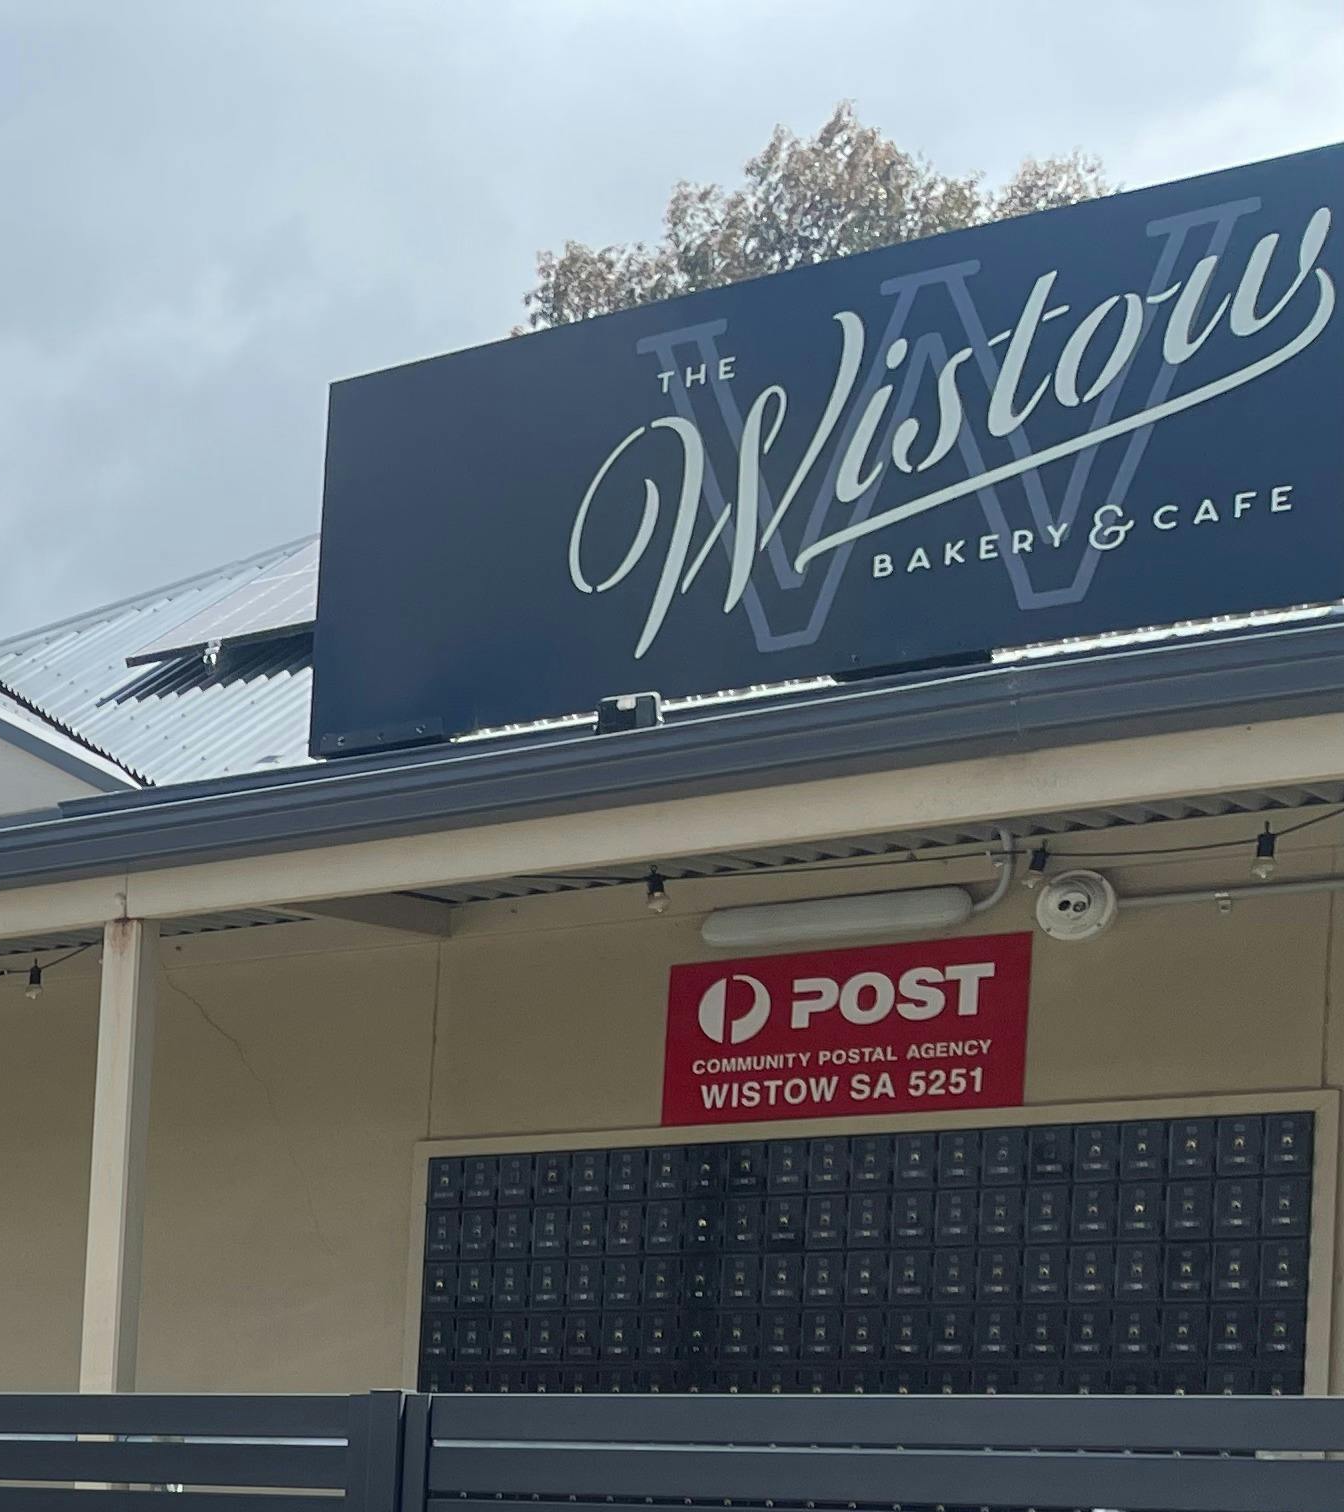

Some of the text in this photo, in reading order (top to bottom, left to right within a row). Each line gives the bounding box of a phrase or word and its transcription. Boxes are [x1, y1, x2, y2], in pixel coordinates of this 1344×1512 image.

[658, 356, 738, 394] THE
[569, 206, 1336, 660] Wistow
[873, 485, 1294, 579] BAKERY & CAFE
[790, 961, 996, 1030] POST
[692, 1038, 993, 1076] COMMUNITY POSTAL AGENCY
[700, 1066, 983, 1110] WISTOW SA 5251
